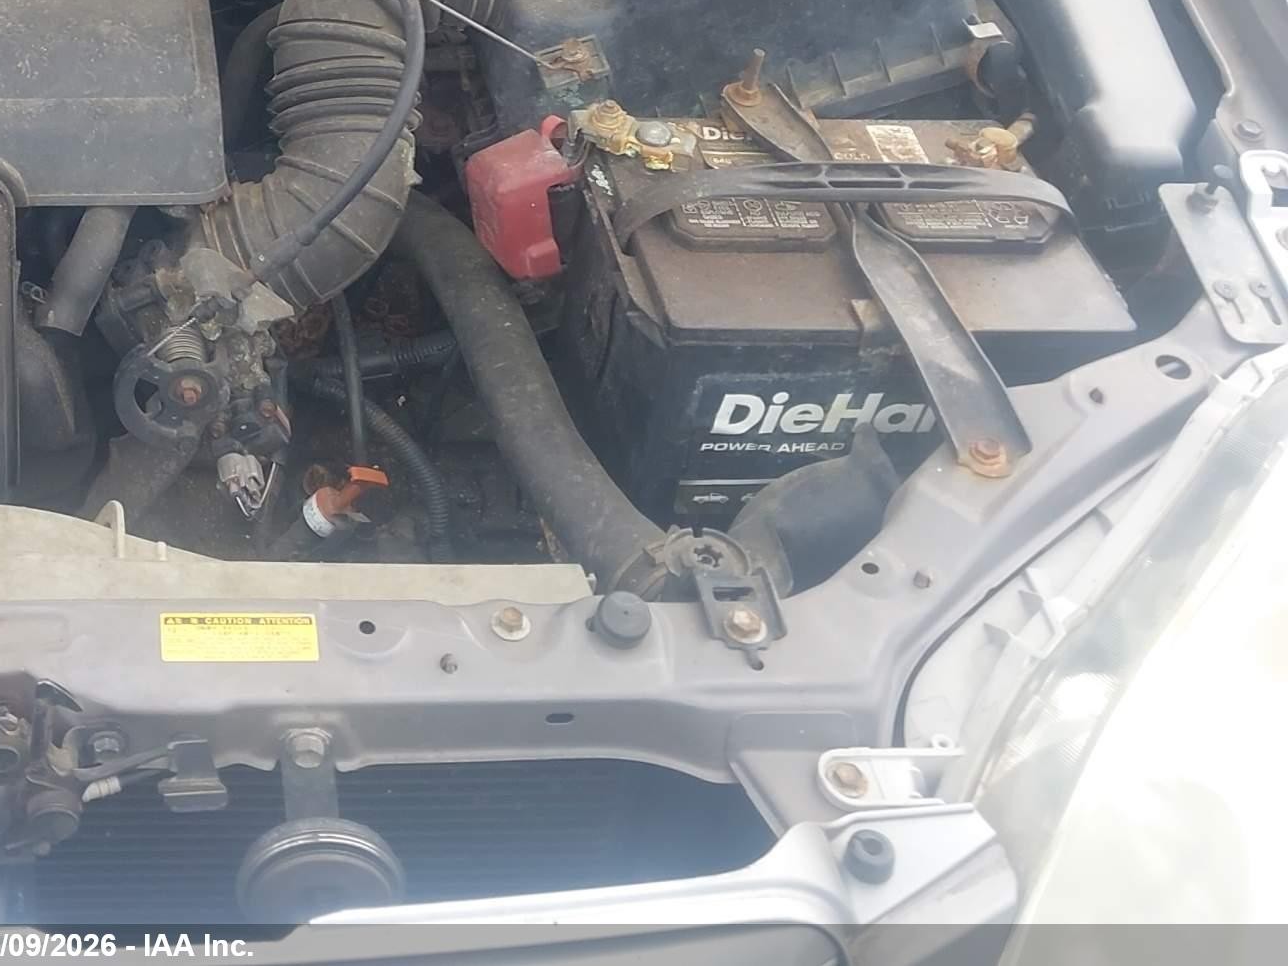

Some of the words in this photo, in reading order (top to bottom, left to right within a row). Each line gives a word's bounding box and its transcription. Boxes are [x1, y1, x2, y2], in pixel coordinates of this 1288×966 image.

[710, 391, 937, 435] DieHar
[699, 441, 772, 453] POWER
[776, 441, 846, 454] AHEAD
[204, 617, 253, 625] CAUTION
[258, 617, 311, 626] ATTENTION
